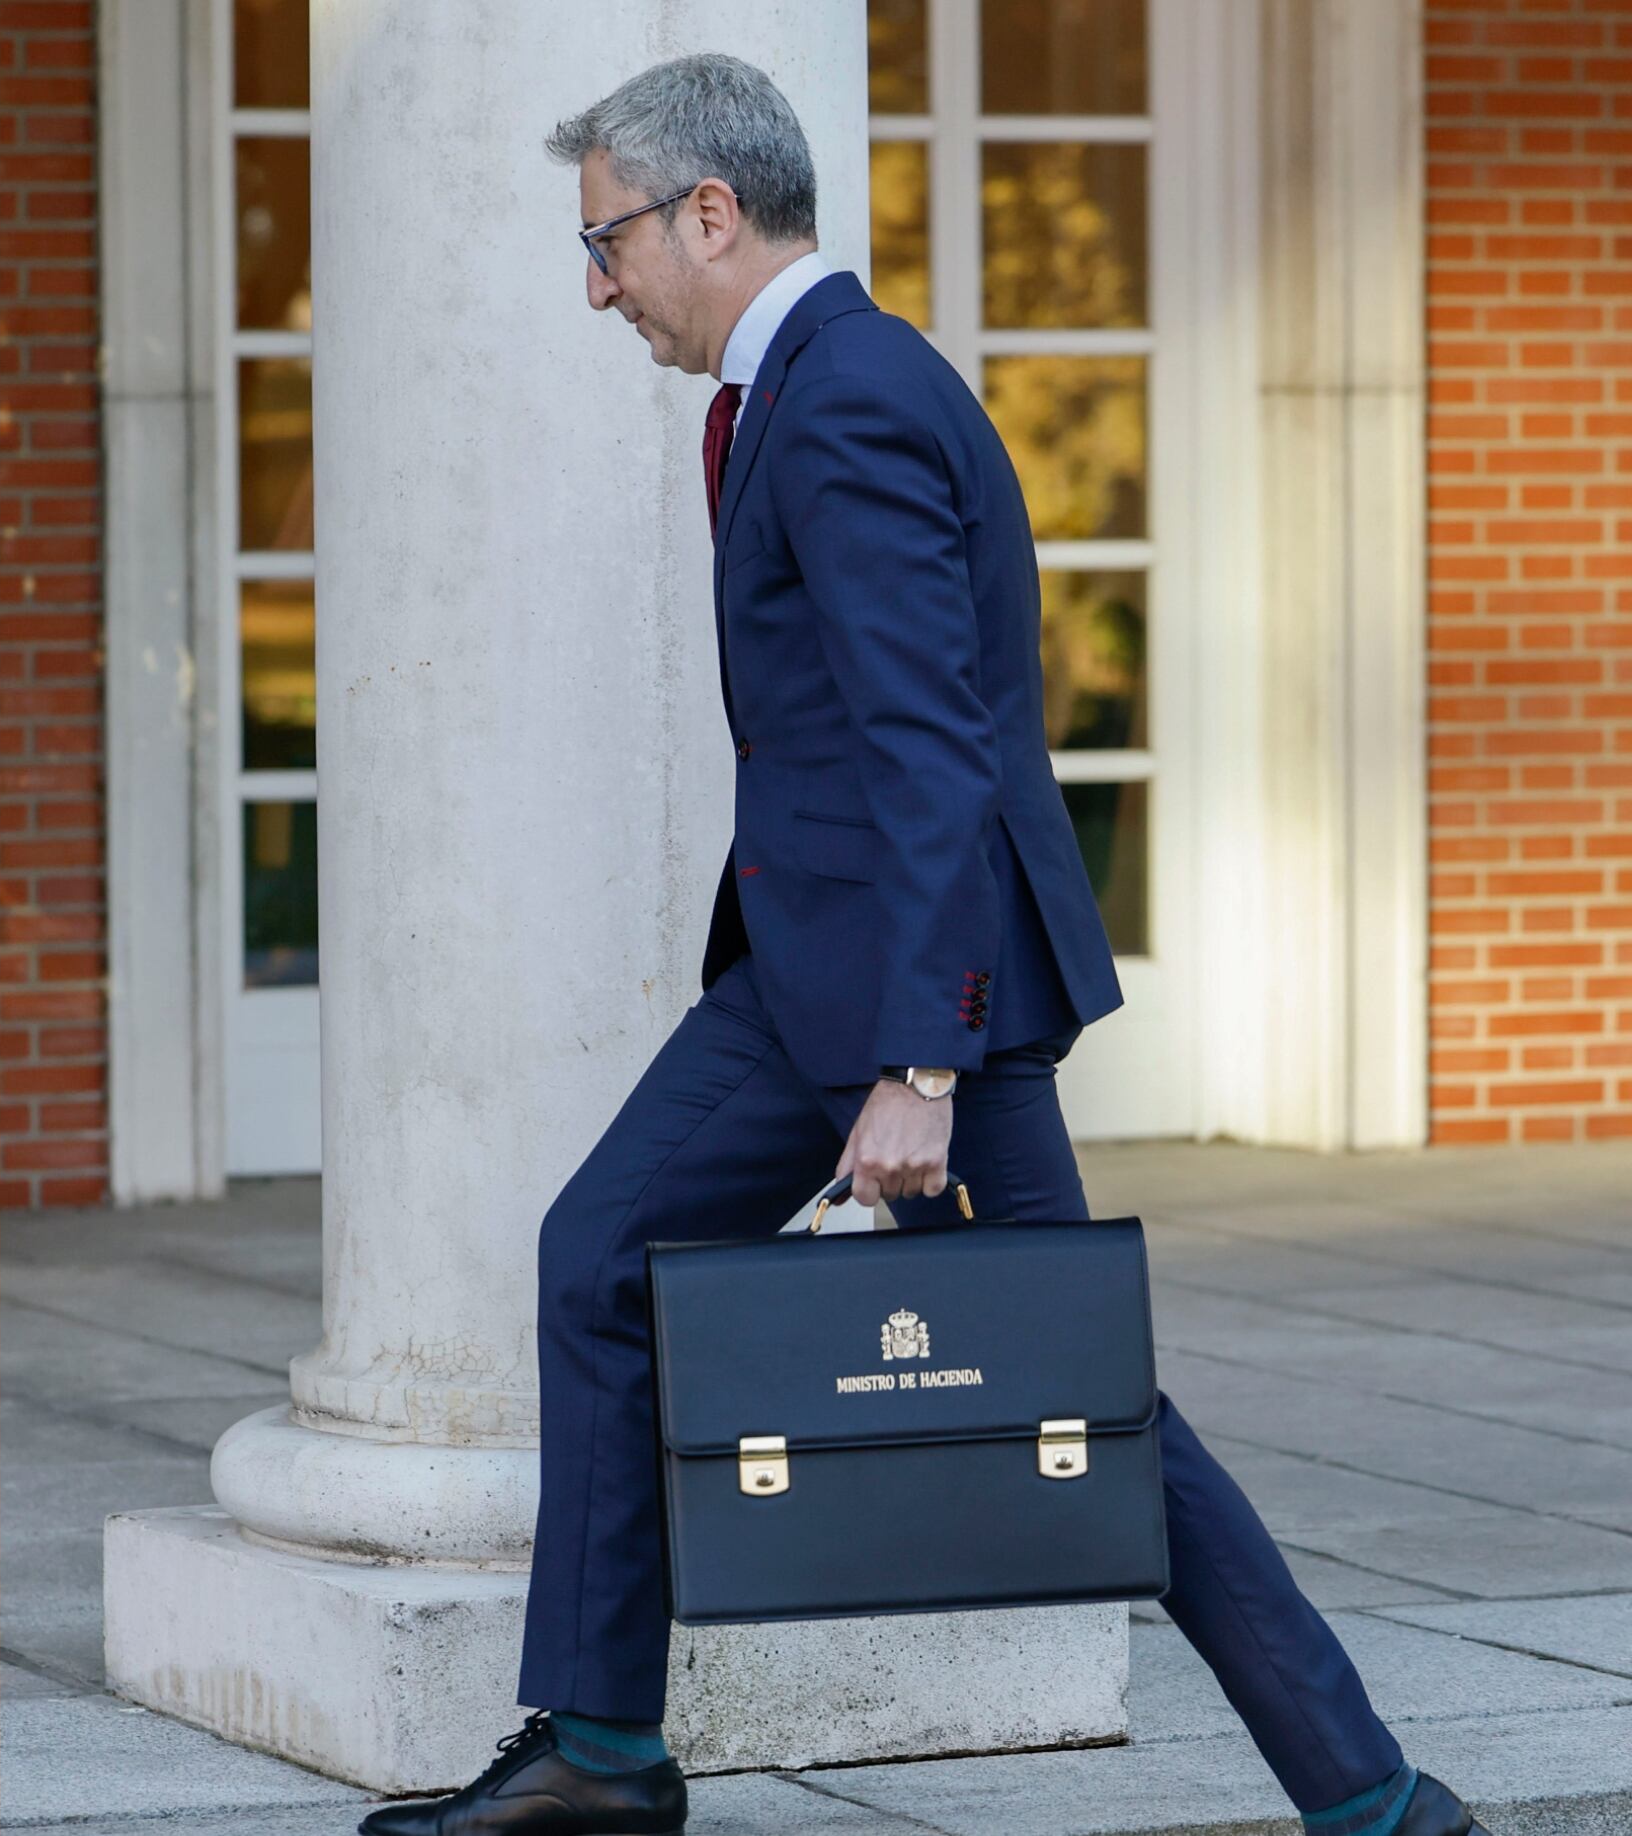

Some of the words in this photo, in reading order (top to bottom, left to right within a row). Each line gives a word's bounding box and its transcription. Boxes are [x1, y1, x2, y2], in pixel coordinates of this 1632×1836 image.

[836, 1373, 896, 1394] MINISTRO
[898, 1372, 917, 1390] DE
[919, 1368, 984, 1389] HACIENDA
